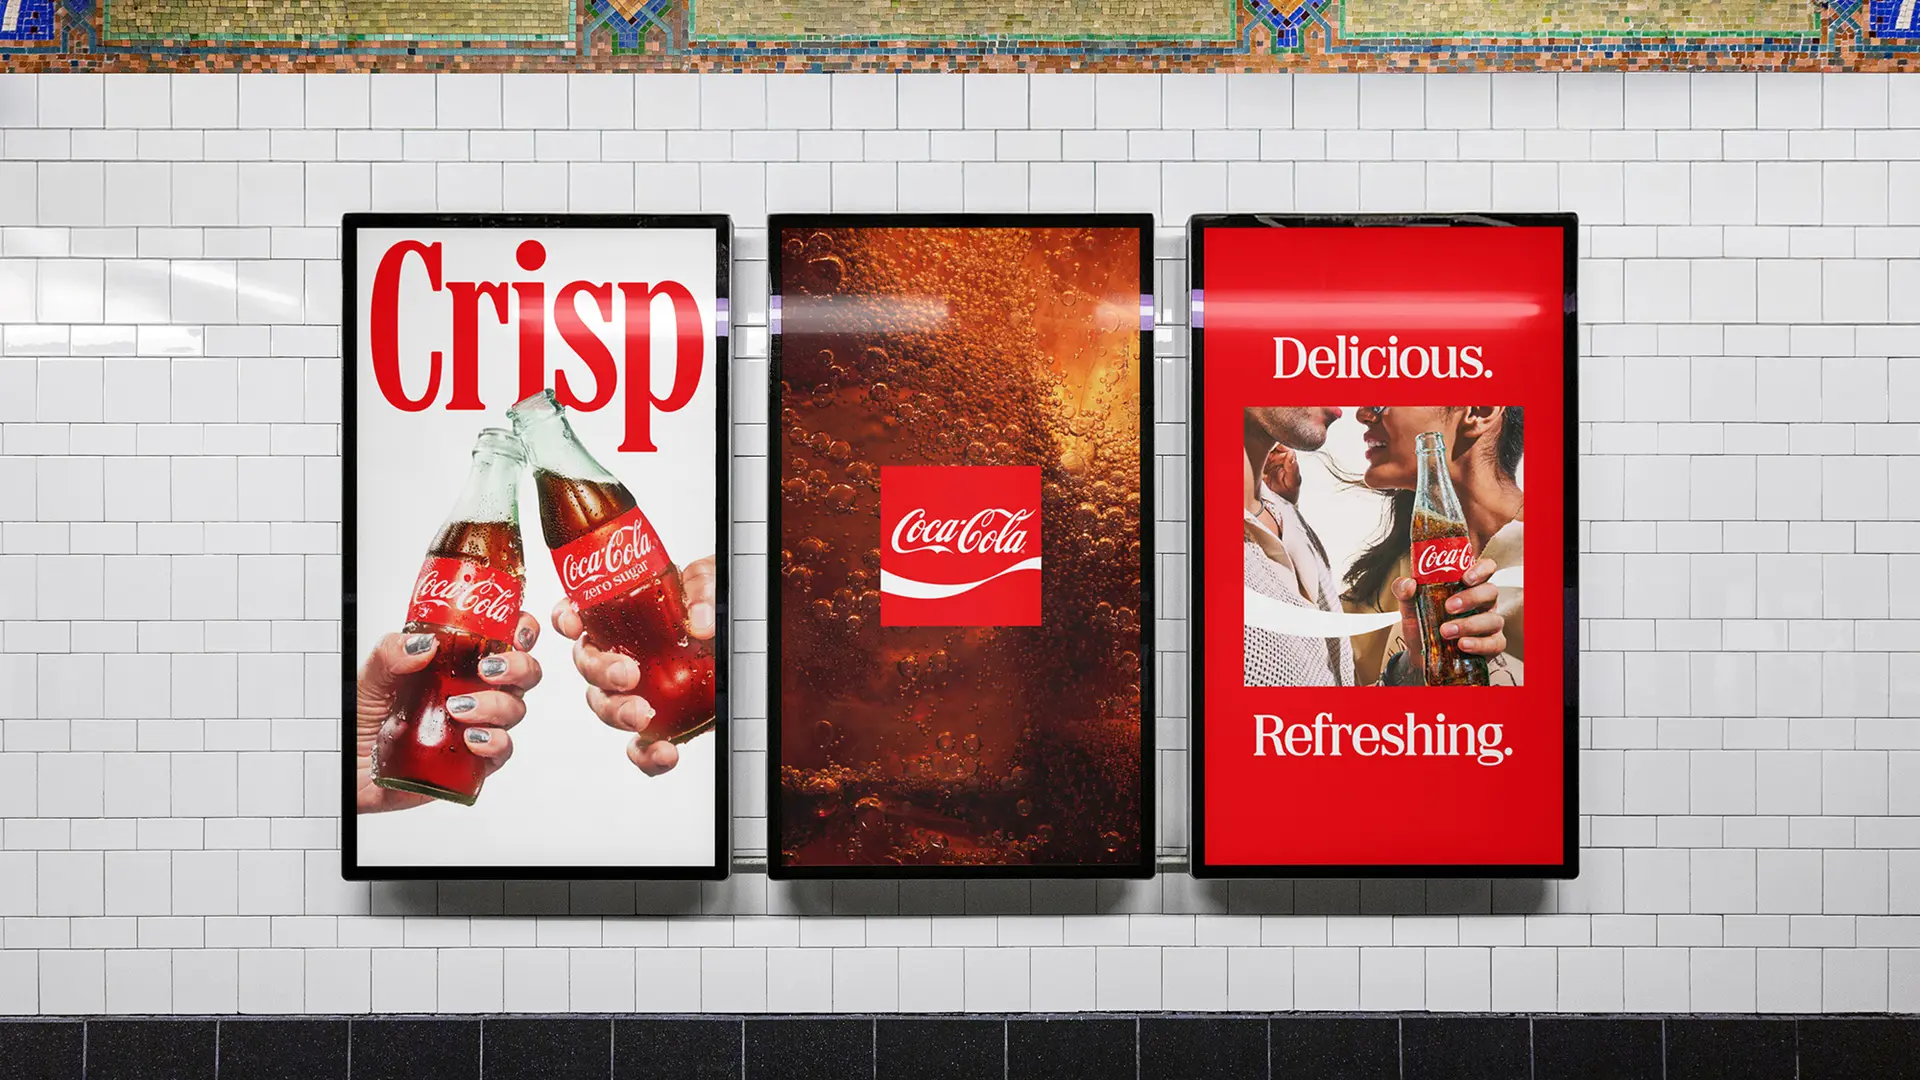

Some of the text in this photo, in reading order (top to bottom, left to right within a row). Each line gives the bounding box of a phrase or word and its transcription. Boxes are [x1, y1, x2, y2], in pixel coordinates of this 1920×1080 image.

[370, 239, 704, 452] Crisp
[1273, 335, 1493, 379] Delicious.
[563, 517, 651, 591] Coca-Cola
[891, 508, 1036, 554] Coca-Cola
[413, 570, 515, 624] Coca-Cola
[582, 559, 650, 601] zero sugar
[1253, 712, 1513, 766] Refreshing.
